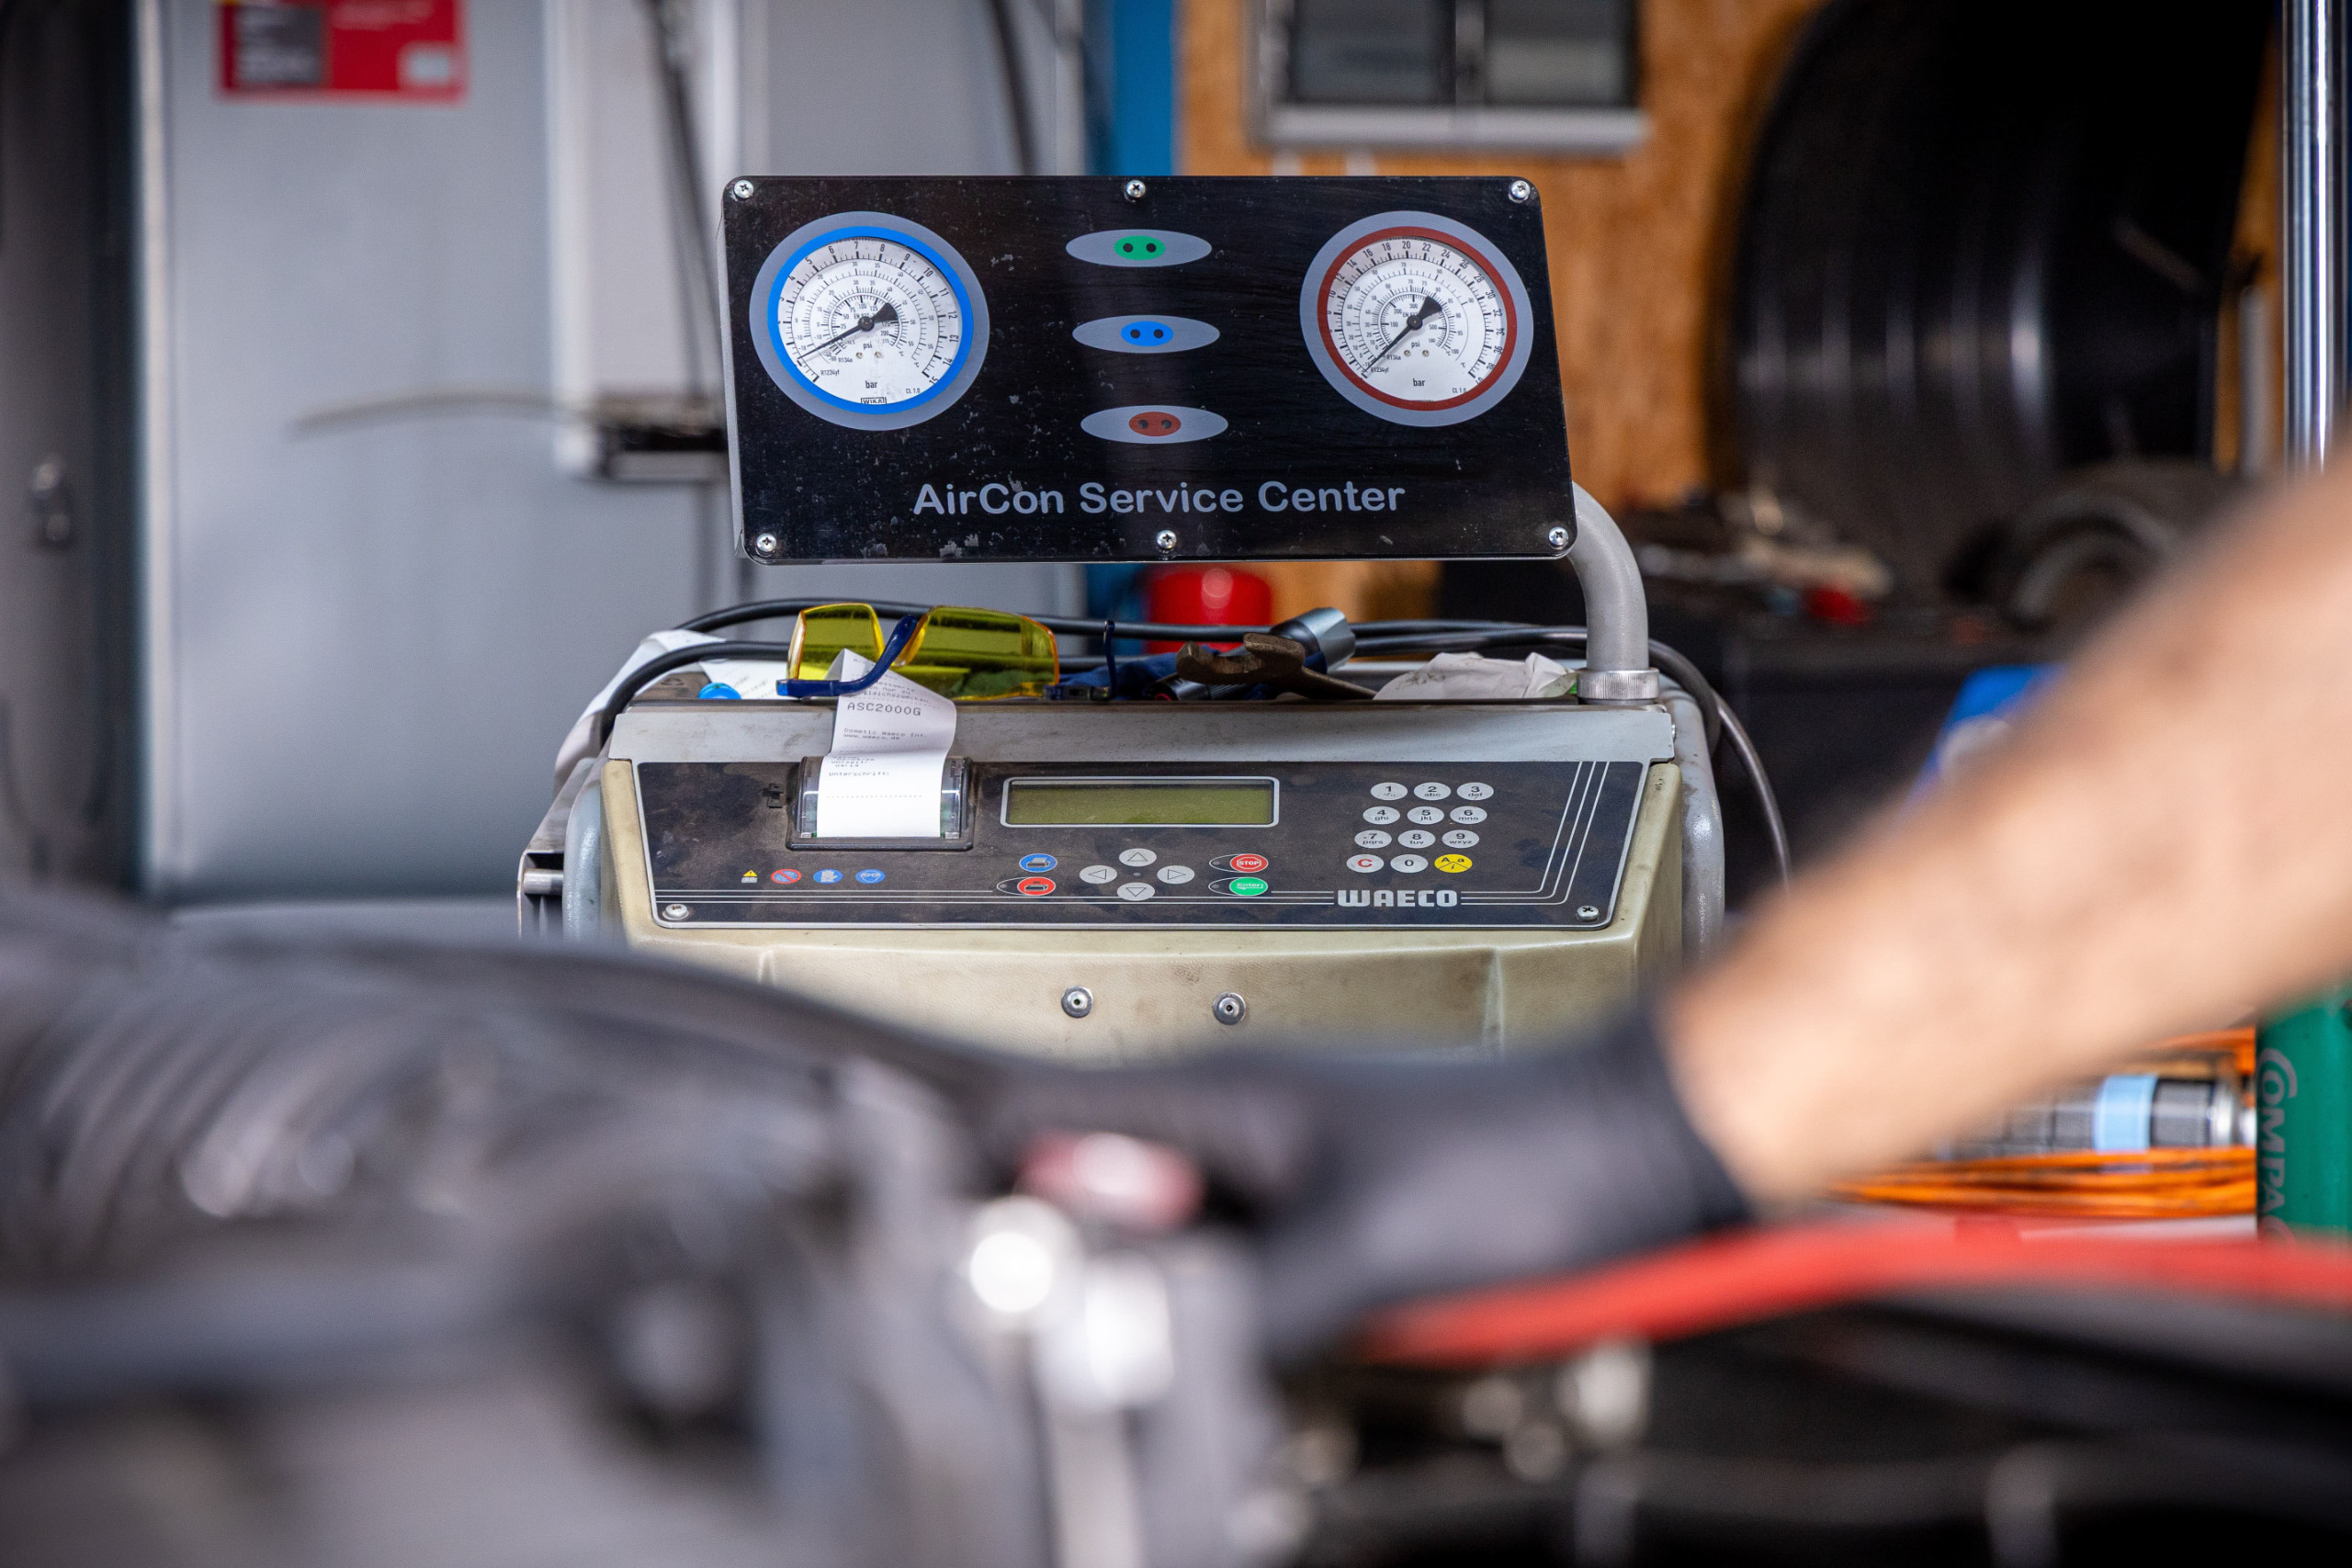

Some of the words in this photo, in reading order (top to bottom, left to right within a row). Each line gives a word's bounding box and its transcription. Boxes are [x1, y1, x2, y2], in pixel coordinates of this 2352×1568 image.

[828, 245, 834, 254] 6
[854, 242, 859, 250] 7
[880, 243, 885, 252] 8
[1382, 243, 1391, 252] 18
[1402, 241, 1411, 250] 20
[1422, 243, 1431, 252] 22
[1363, 248, 1374, 258] 16
[1441, 248, 1451, 259] 24
[1346, 259, 1357, 268] 14
[1459, 259, 1470, 269] 26
[923, 267, 933, 276] 10
[1335, 272, 1345, 282] 12
[1474, 273, 1485, 283] 28
[939, 288, 949, 297] 11
[1485, 289, 1496, 299] 30
[948, 310, 958, 320] 12
[1493, 308, 1503, 317] 32
[1496, 327, 1505, 336] 34
[949, 334, 959, 343] 13
[864, 342, 873, 350] psi
[1493, 345, 1503, 355] 36
[943, 357, 953, 367] 14
[865, 380, 878, 389] bar
[929, 376, 939, 385] 15
[1413, 378, 1425, 387] bar
[913, 483, 1065, 515] AirCon
[1080, 481, 1244, 513] Service
[1258, 480, 1406, 513] Center
[847, 701, 922, 716] ASC2000G
[1357, 858, 1373, 868] C
[1337, 889, 1458, 908] WAECO
